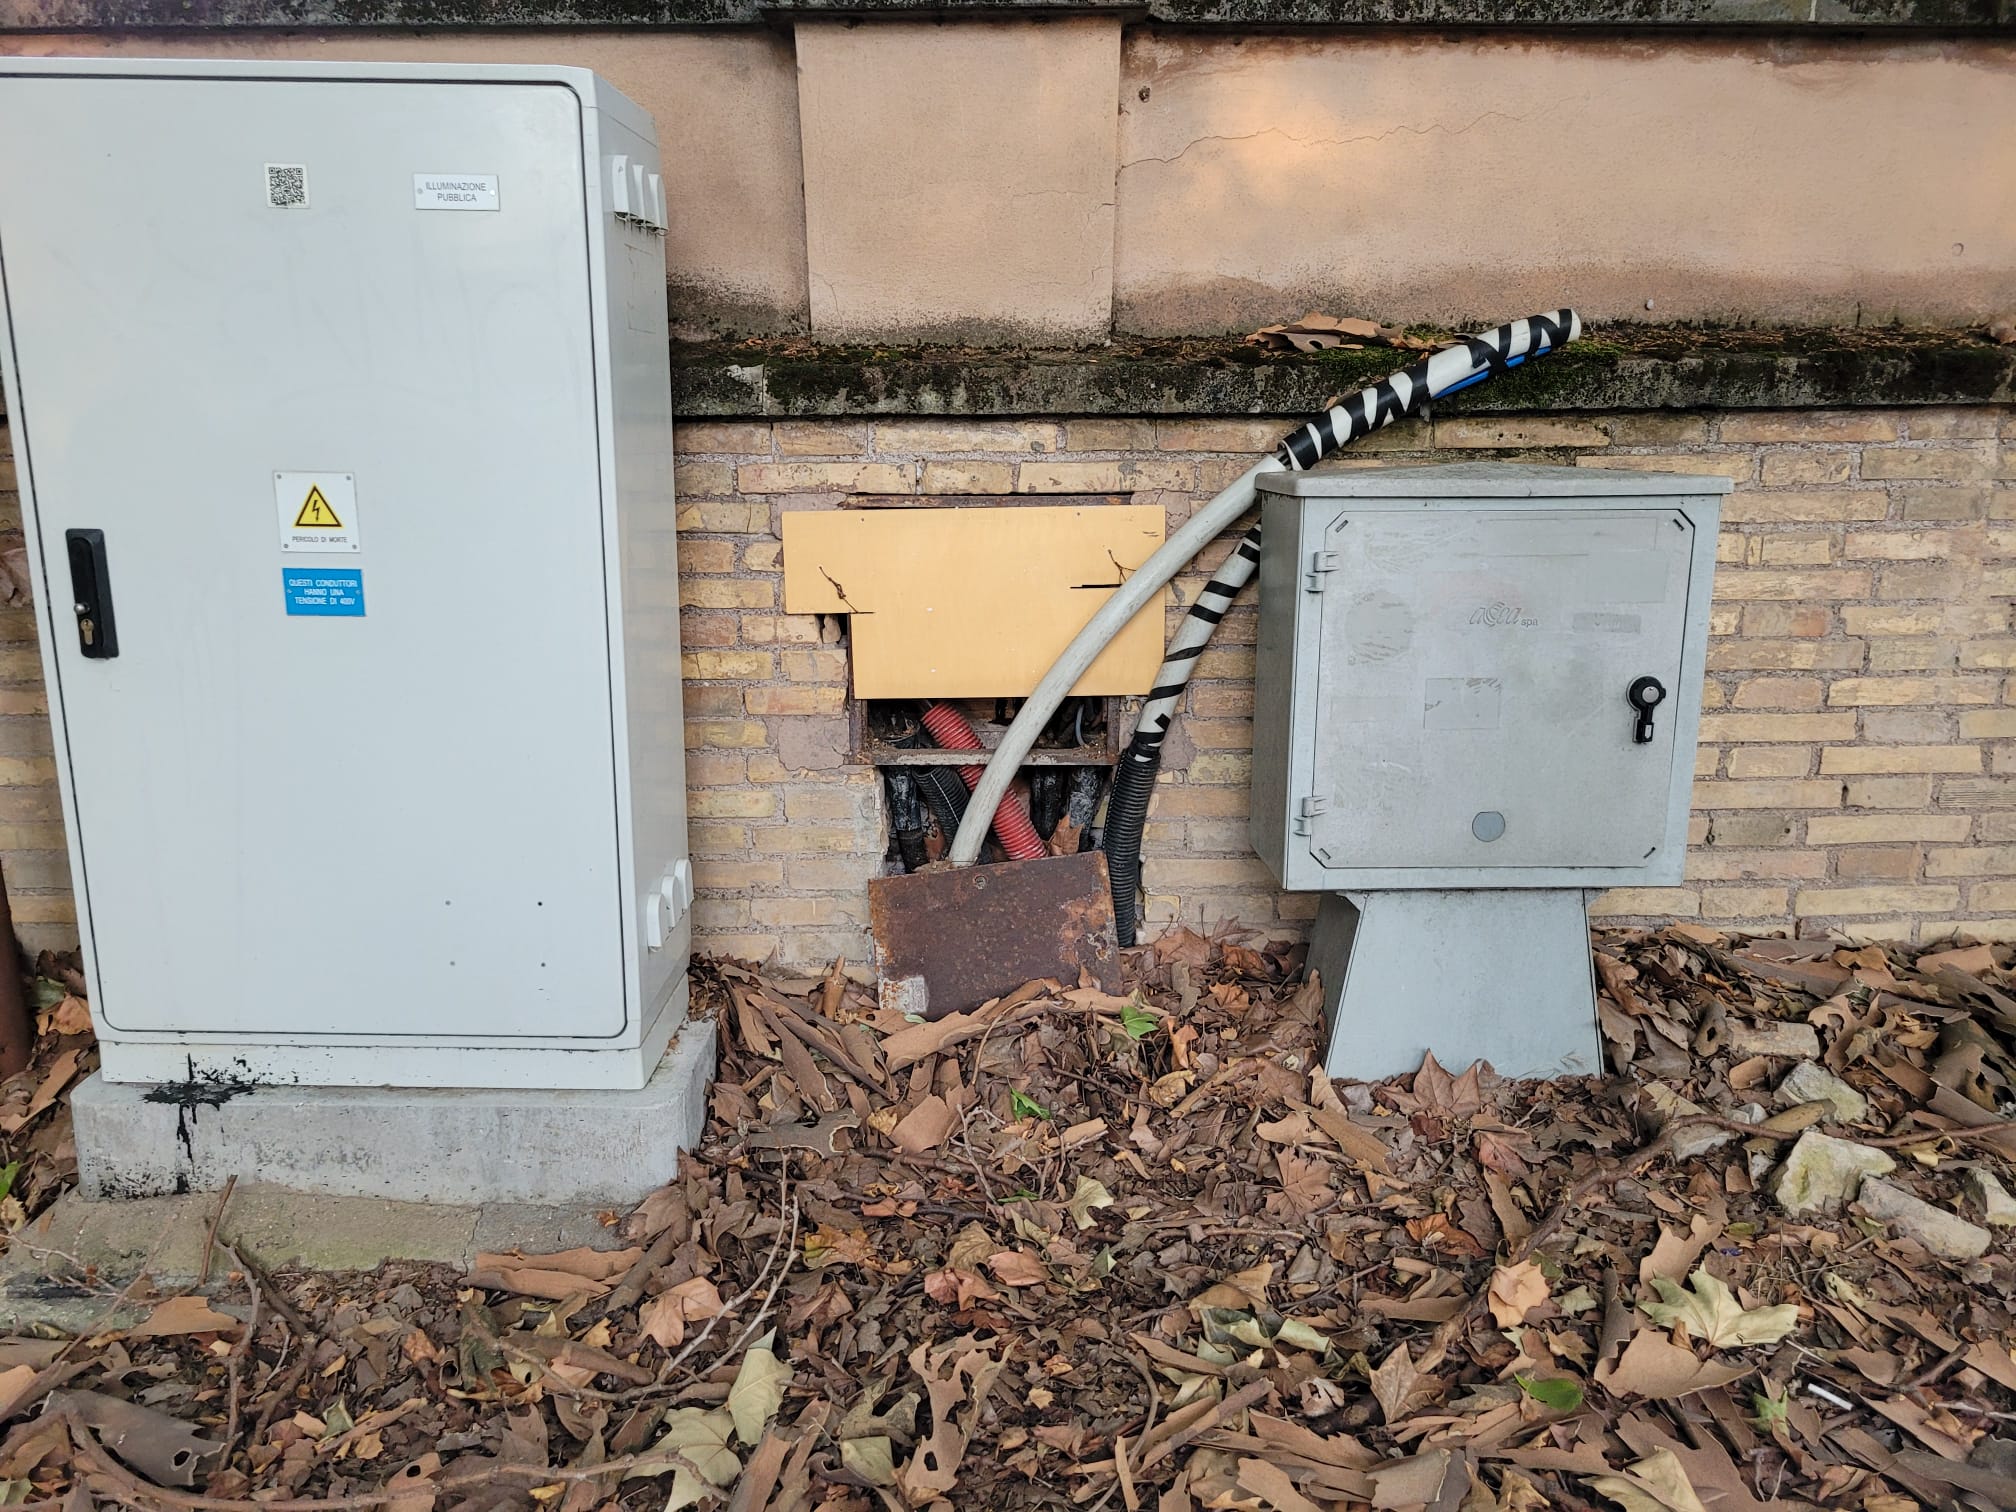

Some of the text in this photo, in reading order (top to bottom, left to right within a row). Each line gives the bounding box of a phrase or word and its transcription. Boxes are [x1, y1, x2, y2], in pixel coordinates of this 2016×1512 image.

[425, 182, 487, 191] ILLUMINAZIONE
[437, 193, 477, 202] PUBBLICA
[292, 535, 319, 543] PERICOLO
[288, 578, 358, 587] QUESTI CONDUTTORI
[304, 588, 344, 596] HANNO UNA
[295, 596, 327, 604] TENSIONE
[329, 597, 337, 605] DI
[1521, 618, 1538, 628] spa
